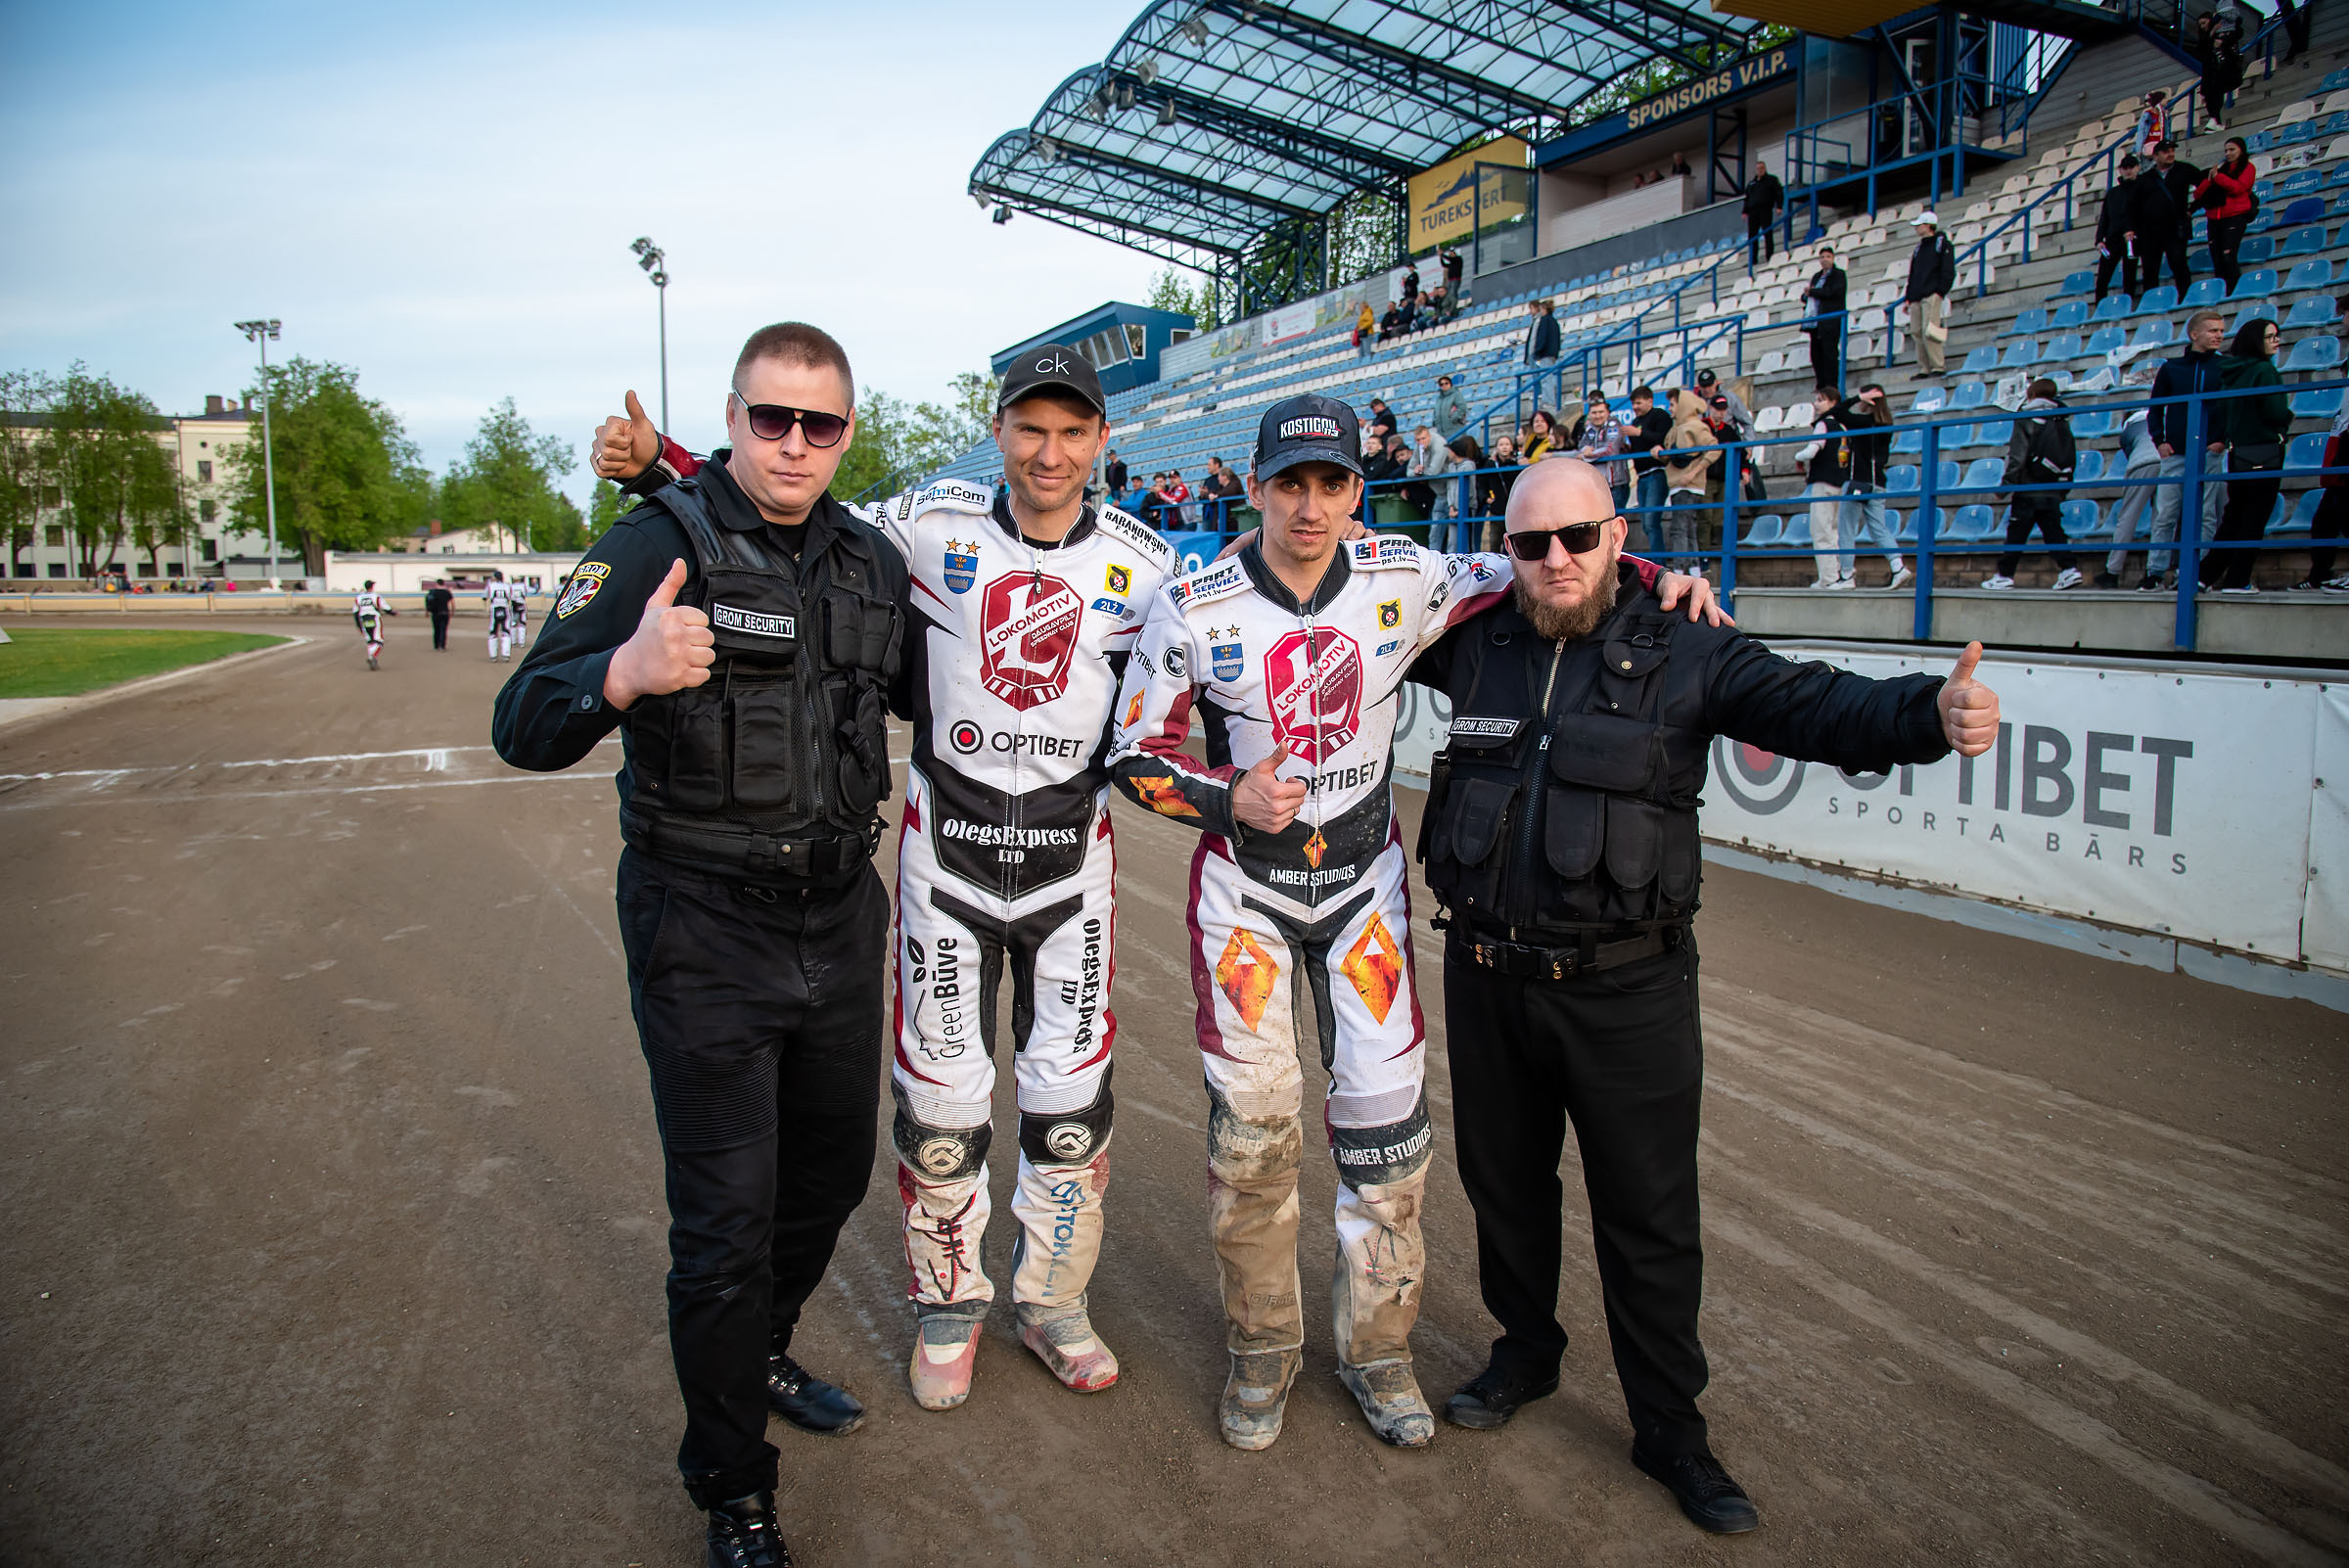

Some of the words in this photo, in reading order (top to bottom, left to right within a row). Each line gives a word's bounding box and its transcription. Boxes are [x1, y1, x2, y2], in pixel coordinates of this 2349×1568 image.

[1628, 70, 1732, 129] SPONSORS
[1738, 51, 1787, 85] V.I.P.
[1420, 183, 1508, 233] TUREKSERT
[1035, 352, 1070, 375] ck
[916, 485, 986, 506] SemiCom
[1115, 525, 1157, 554] FAMILY
[1379, 548, 1419, 558] SERVIC
[577, 565, 608, 576] GROM
[1381, 555, 1406, 566] ps1.lv
[1191, 565, 1235, 587] PART
[1193, 574, 1241, 594] SERVICE
[716, 607, 743, 626] GROM
[744, 615, 793, 635] SECURITY
[989, 593, 1070, 647] LOKOMOTIV
[1031, 612, 1076, 640] DAUGAVPILS
[1030, 627, 1059, 648] SPEEDWAY
[1059, 621, 1075, 632] CLUB
[1134, 646, 1157, 679] PTIBET
[1276, 639, 1346, 712] LOKOMOTIV
[1452, 719, 1478, 731] GROM
[1477, 720, 1516, 733] SECURITY
[990, 731, 1084, 759] OPTIBET
[1835, 721, 2193, 838] IBET
[942, 818, 1078, 849] OlegsExpress
[1828, 797, 2005, 844] SPORTA
[2046, 832, 2188, 875] BĀRS
[997, 849, 1026, 864] LTD
[1268, 868, 1309, 886] AMBER
[1310, 863, 1357, 887] STUDIOS
[932, 937, 966, 1060] GreenBūve
[1061, 979, 1079, 1006] LTD
[1072, 918, 1101, 1055] OlegsExpress
[1339, 1147, 1384, 1167] AMBER
[1383, 1121, 1433, 1164] STUDIOS
